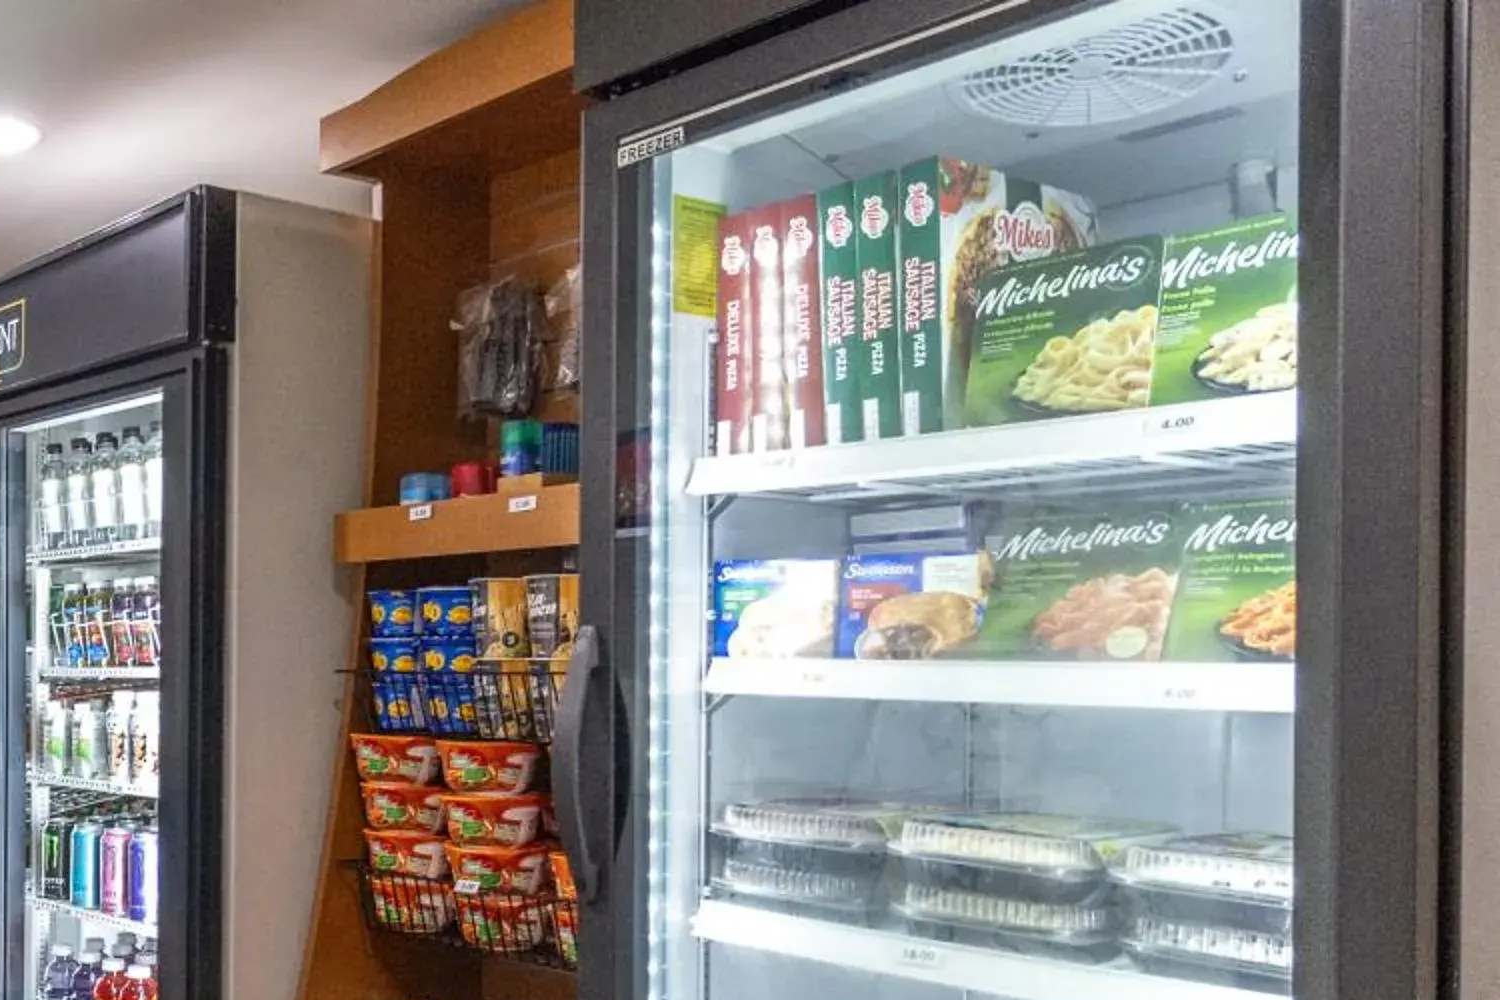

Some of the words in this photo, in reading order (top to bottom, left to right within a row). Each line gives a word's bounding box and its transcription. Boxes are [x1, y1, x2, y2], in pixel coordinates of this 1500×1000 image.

[618, 129, 684, 164] FREEZER
[998, 214, 1052, 256] Mikes
[828, 276, 841, 346] SAUSAGE
[841, 280, 855, 336] ITALIAN
[862, 269, 877, 340] SAUSAGE
[878, 272, 892, 329] ITALIAN
[905, 257, 920, 331] SAUSAGE
[922, 261, 936, 320] ITALIAN
[976, 256, 1145, 319] Michelina's
[836, 347, 847, 381] PIZZA
[872, 342, 883, 375] PIZZA
[913, 333, 927, 367] PIZZA
[994, 520, 1169, 560] Michelina's
